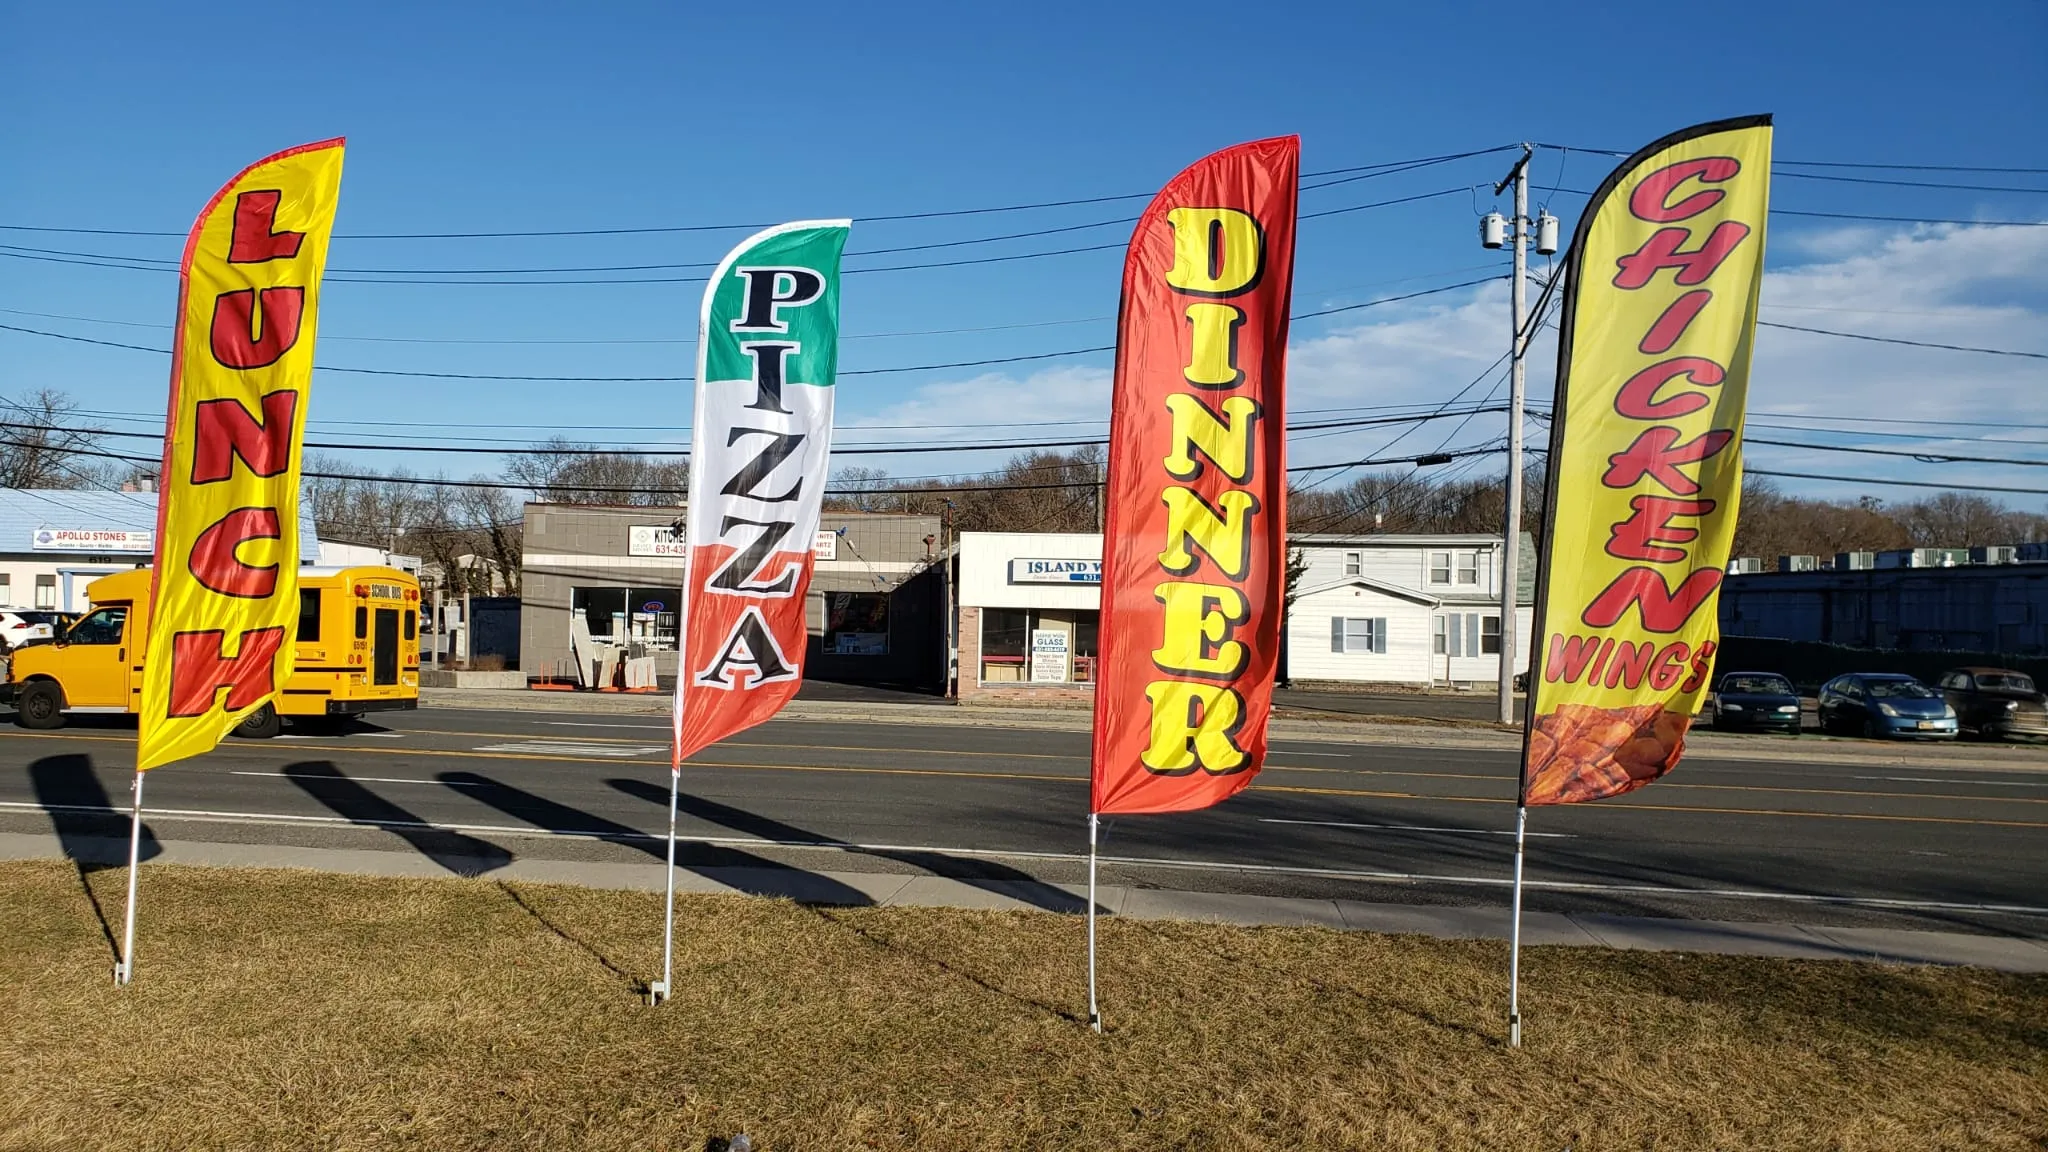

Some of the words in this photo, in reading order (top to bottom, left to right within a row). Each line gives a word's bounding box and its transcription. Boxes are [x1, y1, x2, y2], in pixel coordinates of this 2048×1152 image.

[1581, 155, 1750, 633] CHICKEN
[166, 188, 306, 719] LUNCH
[694, 266, 826, 690] PIZZA
[1141, 207, 1265, 777] DINNER
[56, 531, 90, 541] APOLLO
[93, 532, 127, 541] STONES
[372, 584, 389, 598] SCHOOL
[391, 586, 401, 599] BUS
[1028, 561, 1087, 574] ISLAND
[1037, 638, 1064, 646] GLASS
[1545, 634, 1716, 694] WINGS
